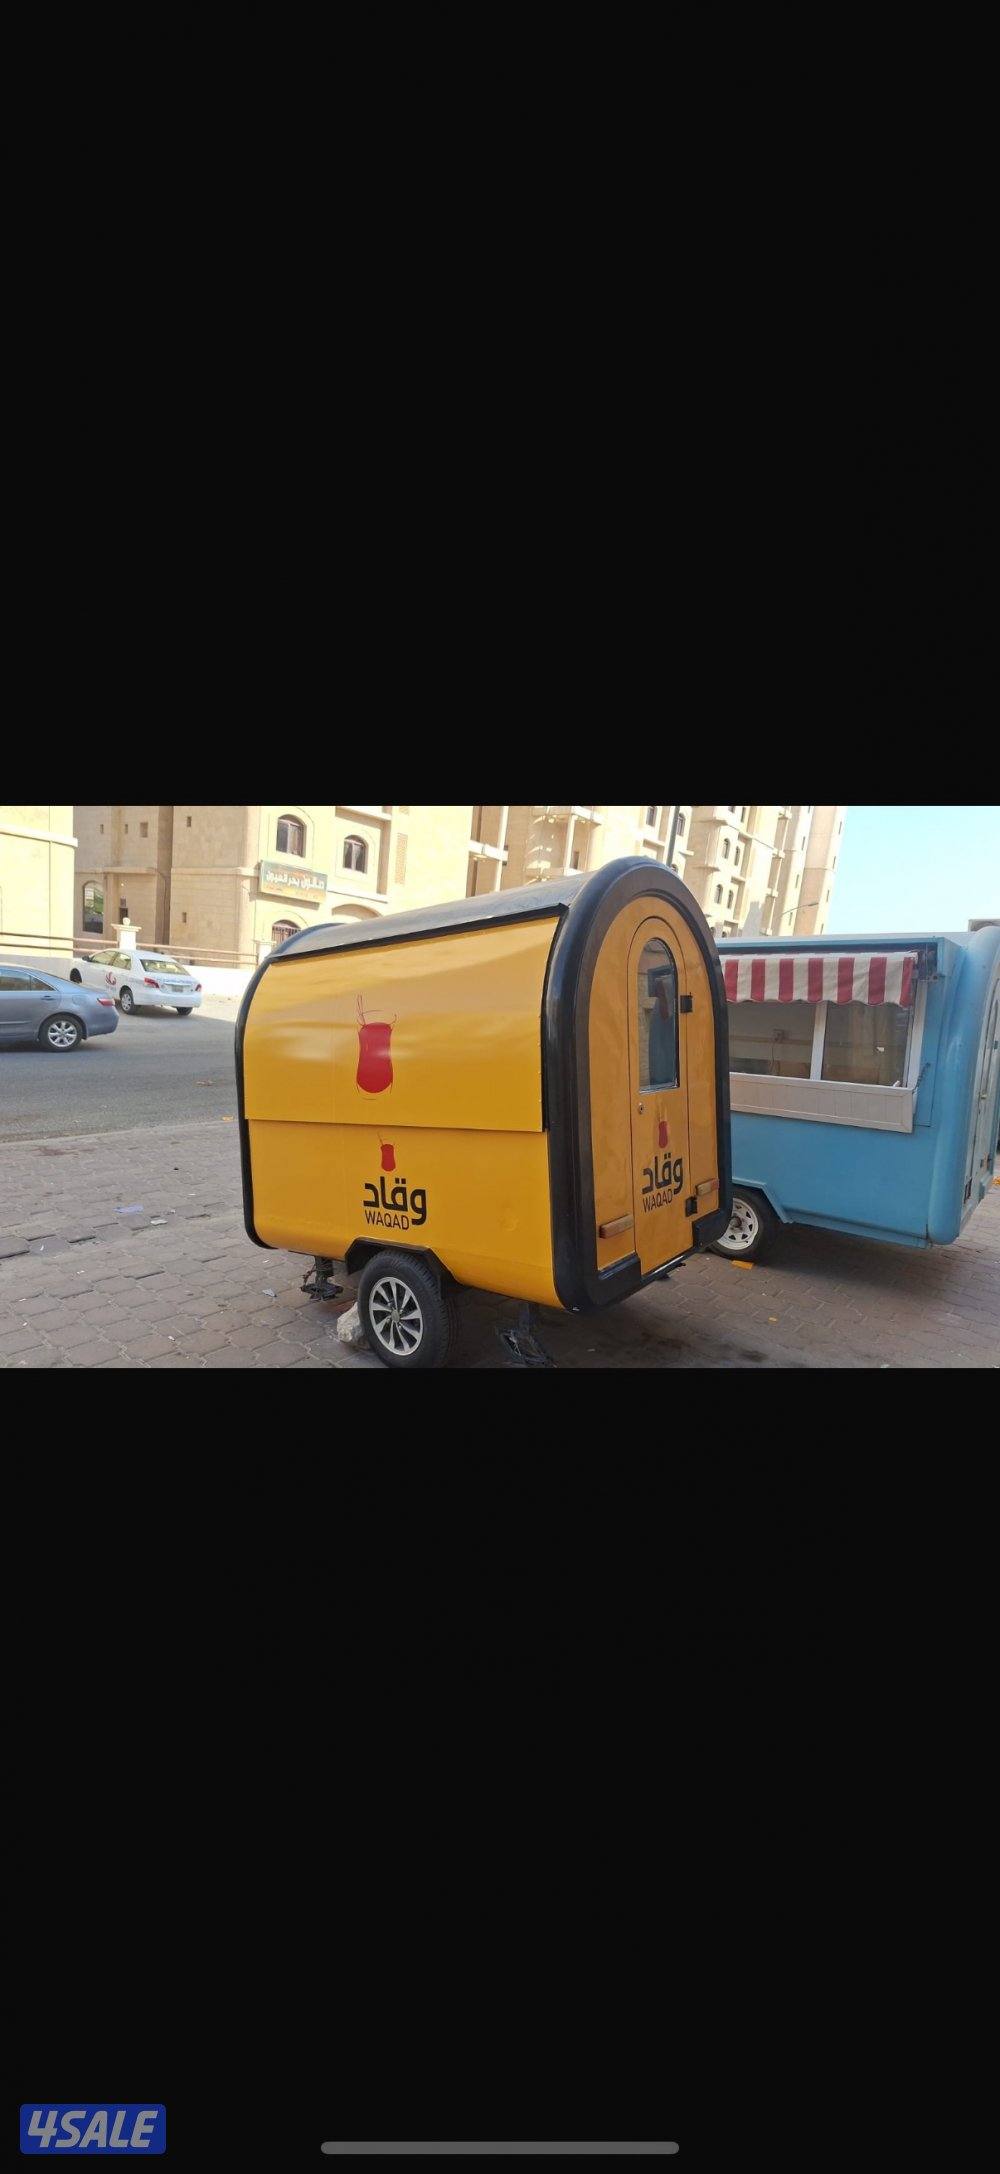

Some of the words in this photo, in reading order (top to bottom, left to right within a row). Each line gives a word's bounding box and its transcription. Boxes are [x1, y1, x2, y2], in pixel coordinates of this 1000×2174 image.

[642, 1152, 683, 1195] وقاد
[363, 1176, 427, 1226] وقاد
[643, 1188, 673, 1213] WAQAD
[365, 1210, 410, 1230] WAQAD
